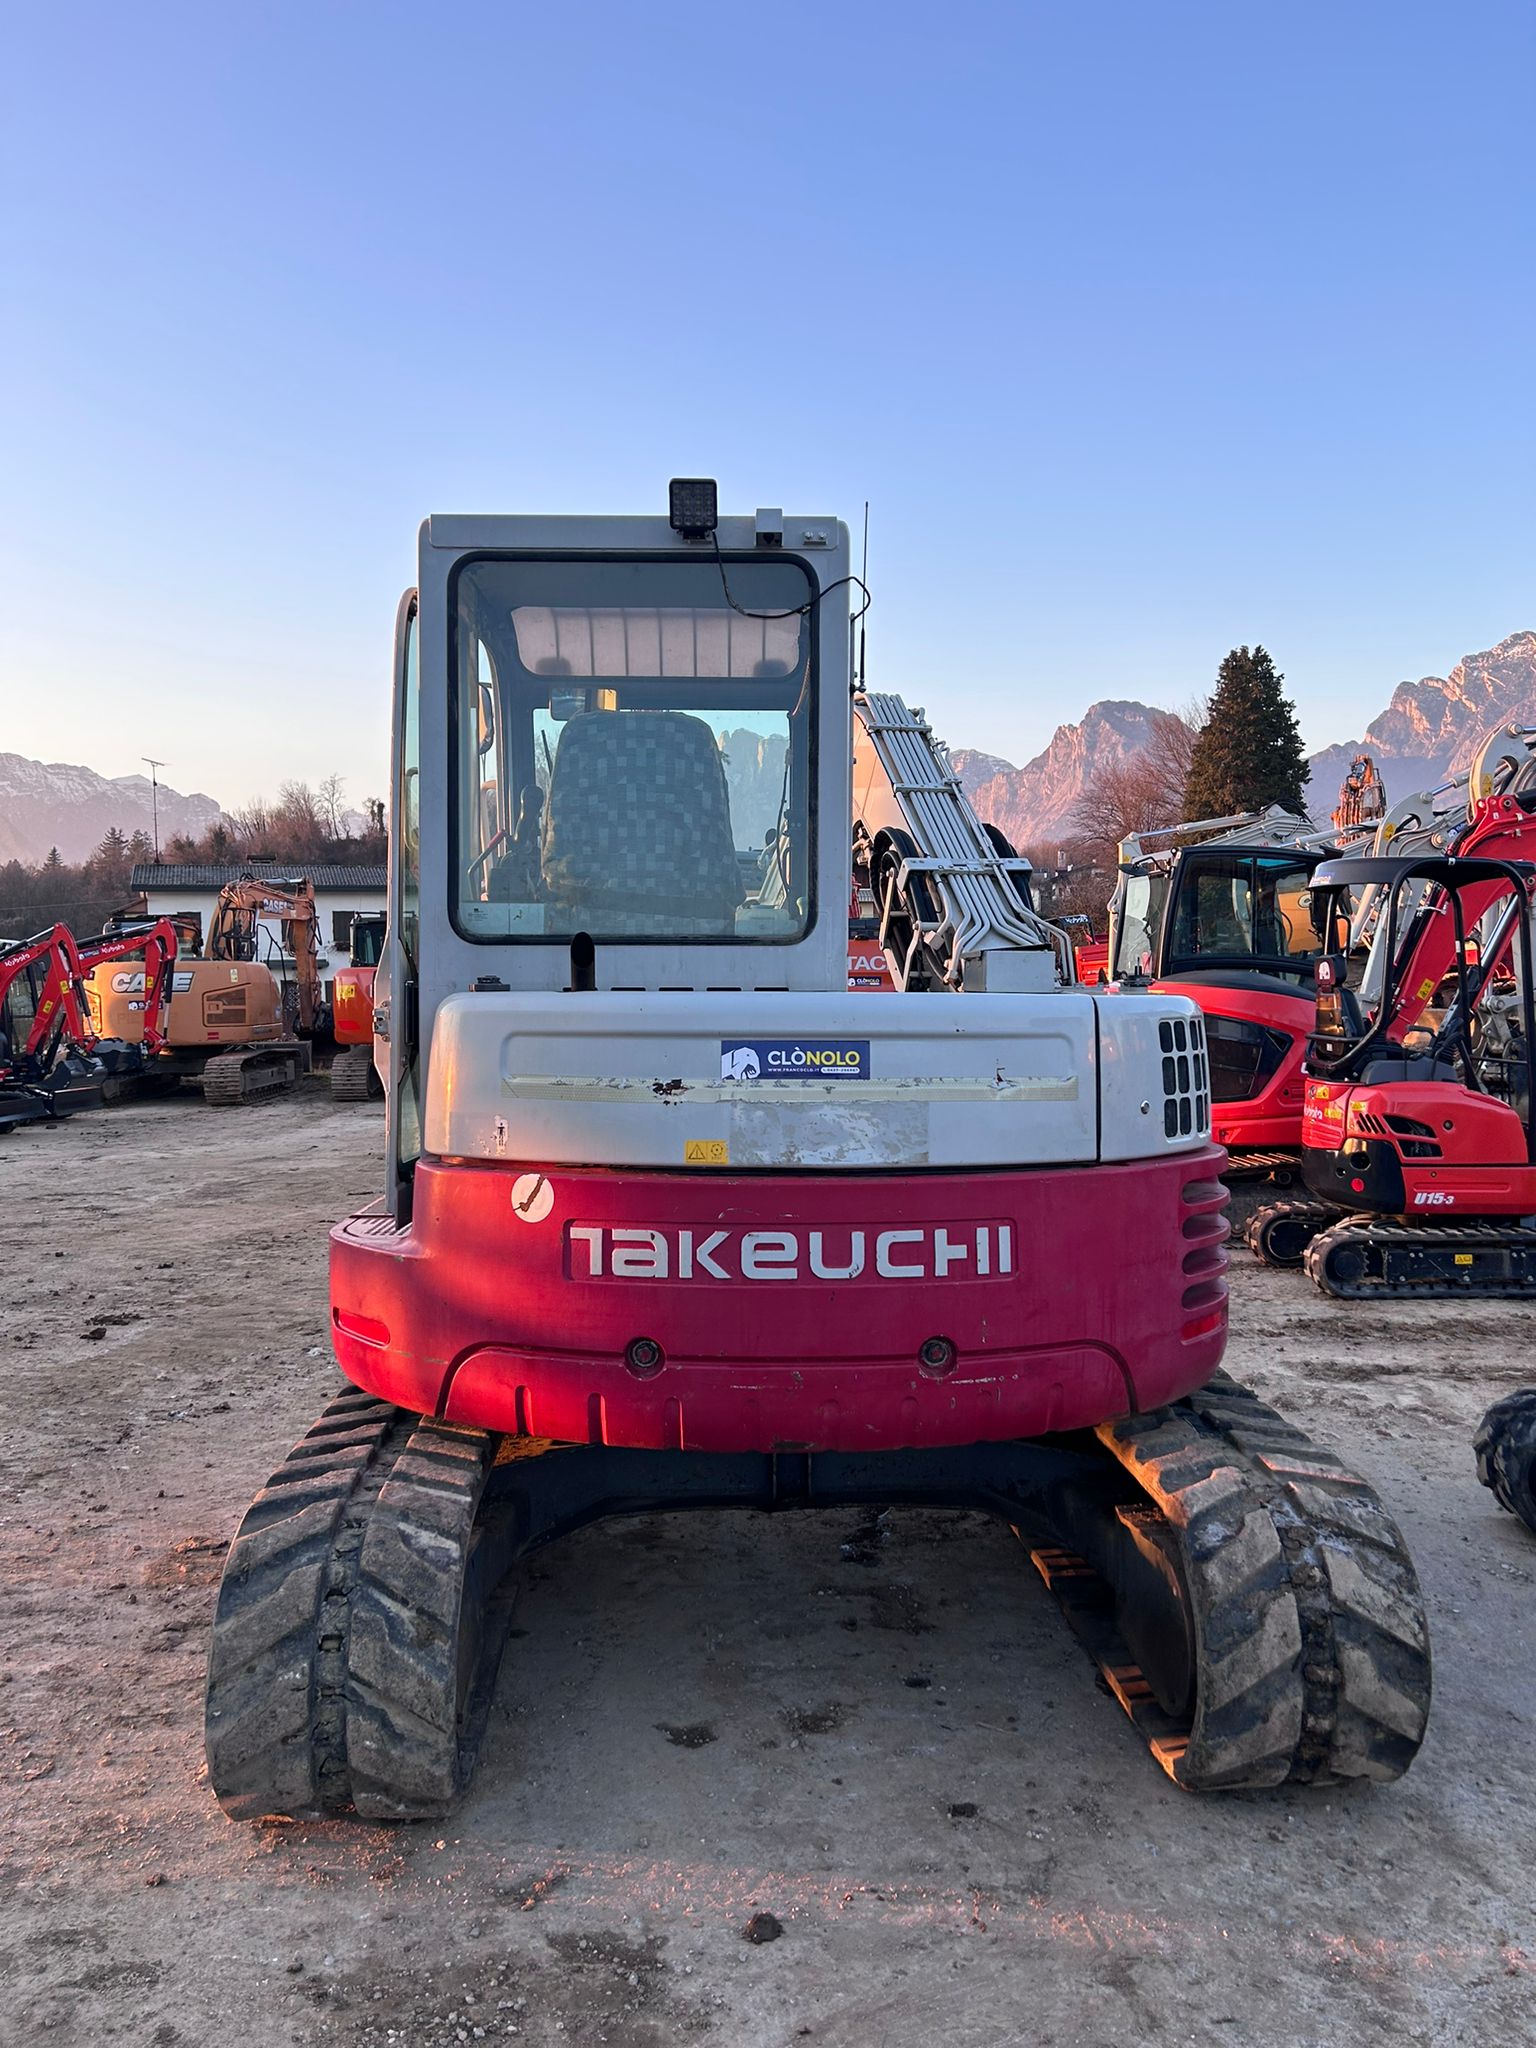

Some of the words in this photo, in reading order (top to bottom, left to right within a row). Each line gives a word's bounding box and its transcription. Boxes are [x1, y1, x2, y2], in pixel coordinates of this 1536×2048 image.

[101, 944, 125, 954] Kubota
[4, 953, 31, 967] Kubota
[111, 972, 194, 992] CAE
[767, 1046, 860, 1065] CLÒNOLO
[1414, 1192, 1454, 1204] U15-3
